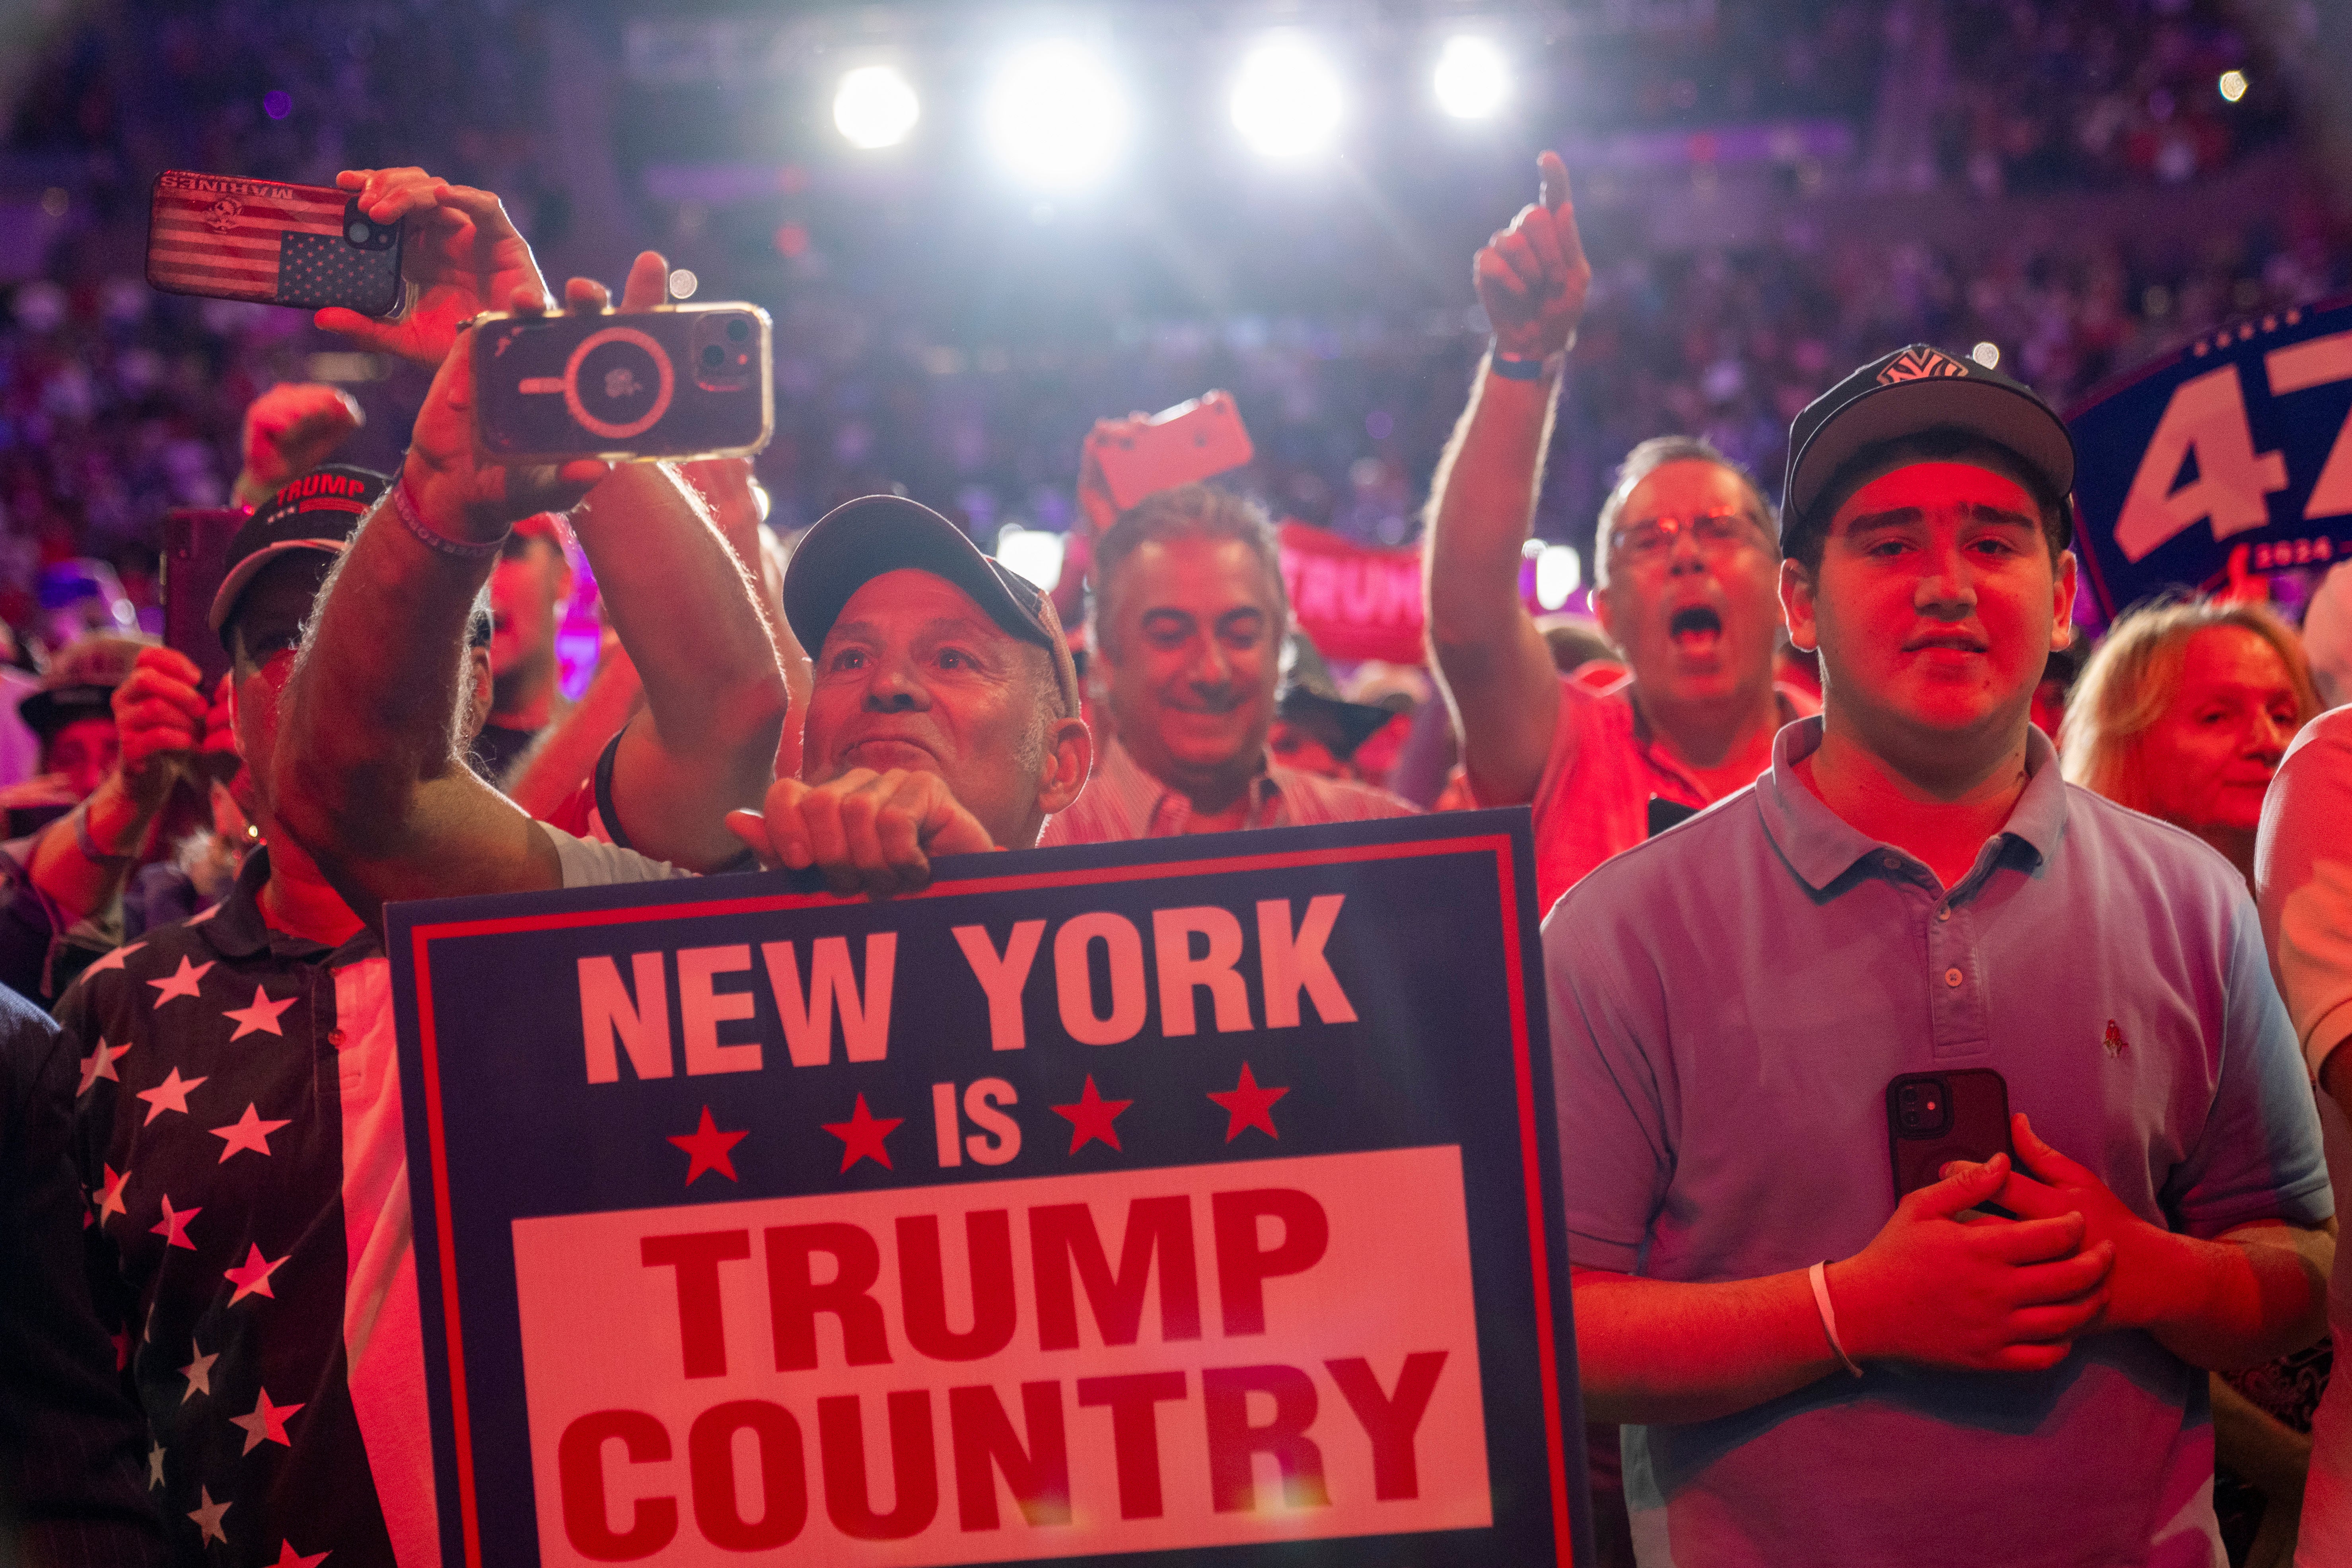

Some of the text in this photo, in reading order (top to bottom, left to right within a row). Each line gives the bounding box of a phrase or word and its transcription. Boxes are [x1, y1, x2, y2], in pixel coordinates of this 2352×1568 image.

[161, 176, 294, 199] MARINES
[276, 473, 365, 507] TRUMP
[2113, 329, 2352, 564] 47
[577, 893, 1359, 1084] NEW YORK
[932, 1076, 1022, 1167] IS
[640, 1188, 1330, 1379] TRUMP
[558, 1351, 1450, 1562] COUNTRY
